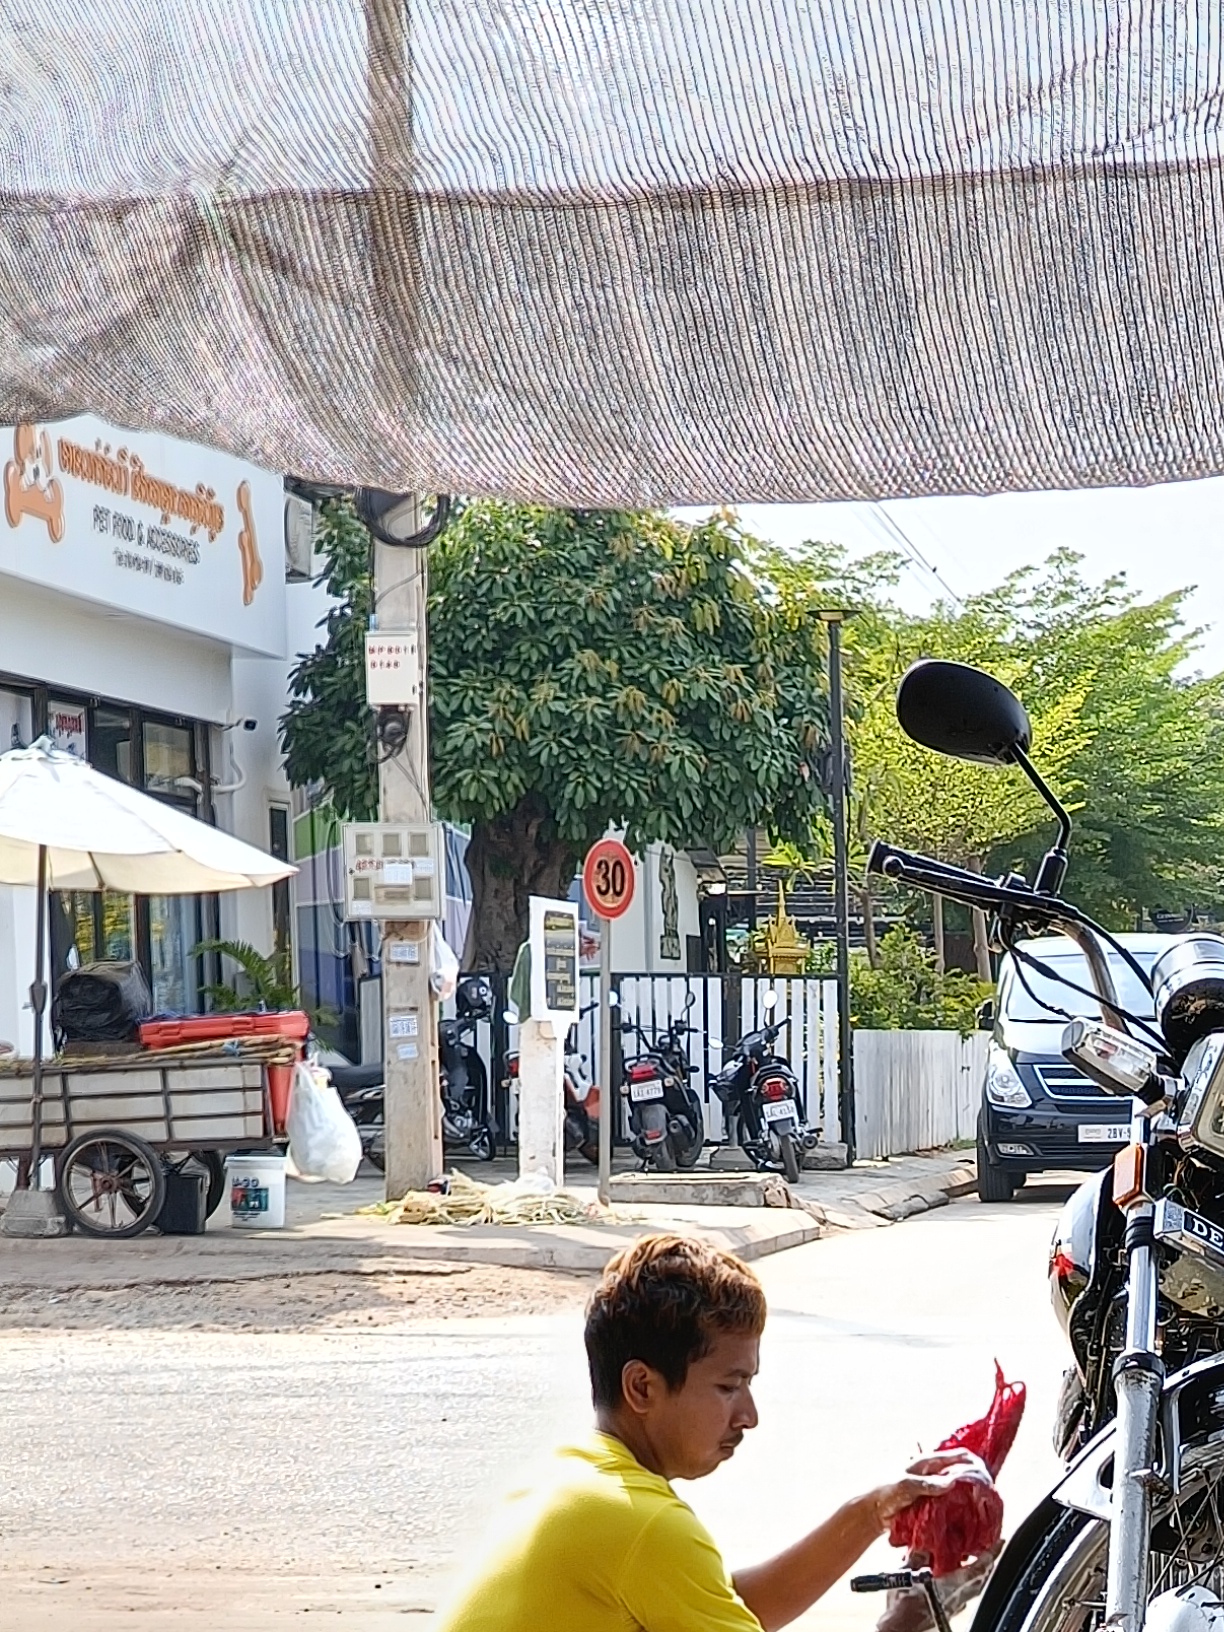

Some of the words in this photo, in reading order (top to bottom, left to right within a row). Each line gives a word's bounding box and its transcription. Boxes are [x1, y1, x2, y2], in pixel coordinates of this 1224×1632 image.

[93, 505, 111, 534] PET
[113, 511, 136, 542] FOOD
[595, 859, 626, 898] 30
